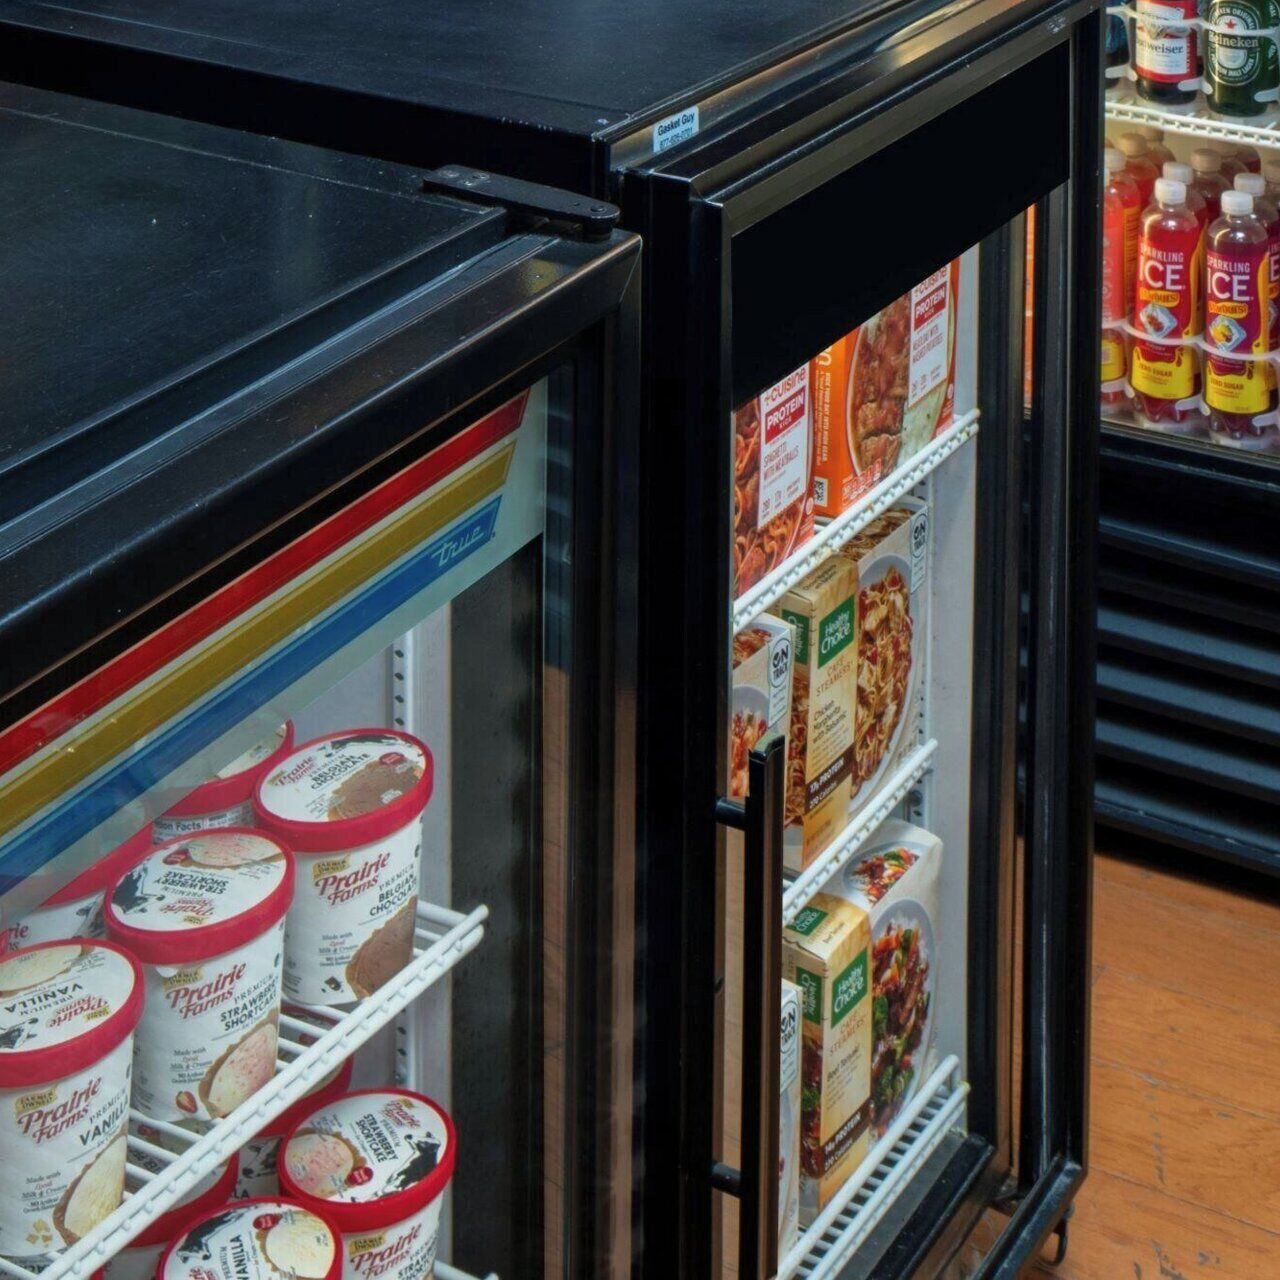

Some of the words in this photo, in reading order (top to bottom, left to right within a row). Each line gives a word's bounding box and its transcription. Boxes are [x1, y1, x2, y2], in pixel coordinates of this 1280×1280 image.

[682, 112, 696, 126] Guy
[1140, 244, 1185, 264] SPARKLING
[1207, 254, 1251, 274] SPARKLING
[1139, 263, 1184, 291] ICE
[1206, 268, 1251, 302] ICE
[915, 288, 947, 318] PROTEIN
[766, 392, 806, 429] PROTEIN
[821, 622, 851, 654] Choice
[310, 752, 371, 790] CHOCOLATE
[311, 753, 358, 782] BELGIAN
[175, 821, 202, 832] Facts
[314, 852, 392, 896] Prairie
[327, 874, 380, 906] Farms
[378, 873, 415, 903] BELGIAN
[3, 982, 84, 1014] VANILLA
[166, 962, 247, 1009] Prairie
[832, 976, 865, 1012] Choice
[179, 988, 234, 1020] Farms
[16, 1076, 103, 1135] Prairie
[31, 1103, 91, 1144] Farms
[362, 1112, 399, 1162] STRAWBERRY
[833, 1110, 863, 1150] PROTEIN
[355, 1120, 388, 1164] SHORTCAKE
[350, 1222, 423, 1269] Prairie
[361, 1248, 410, 1280] Farms
